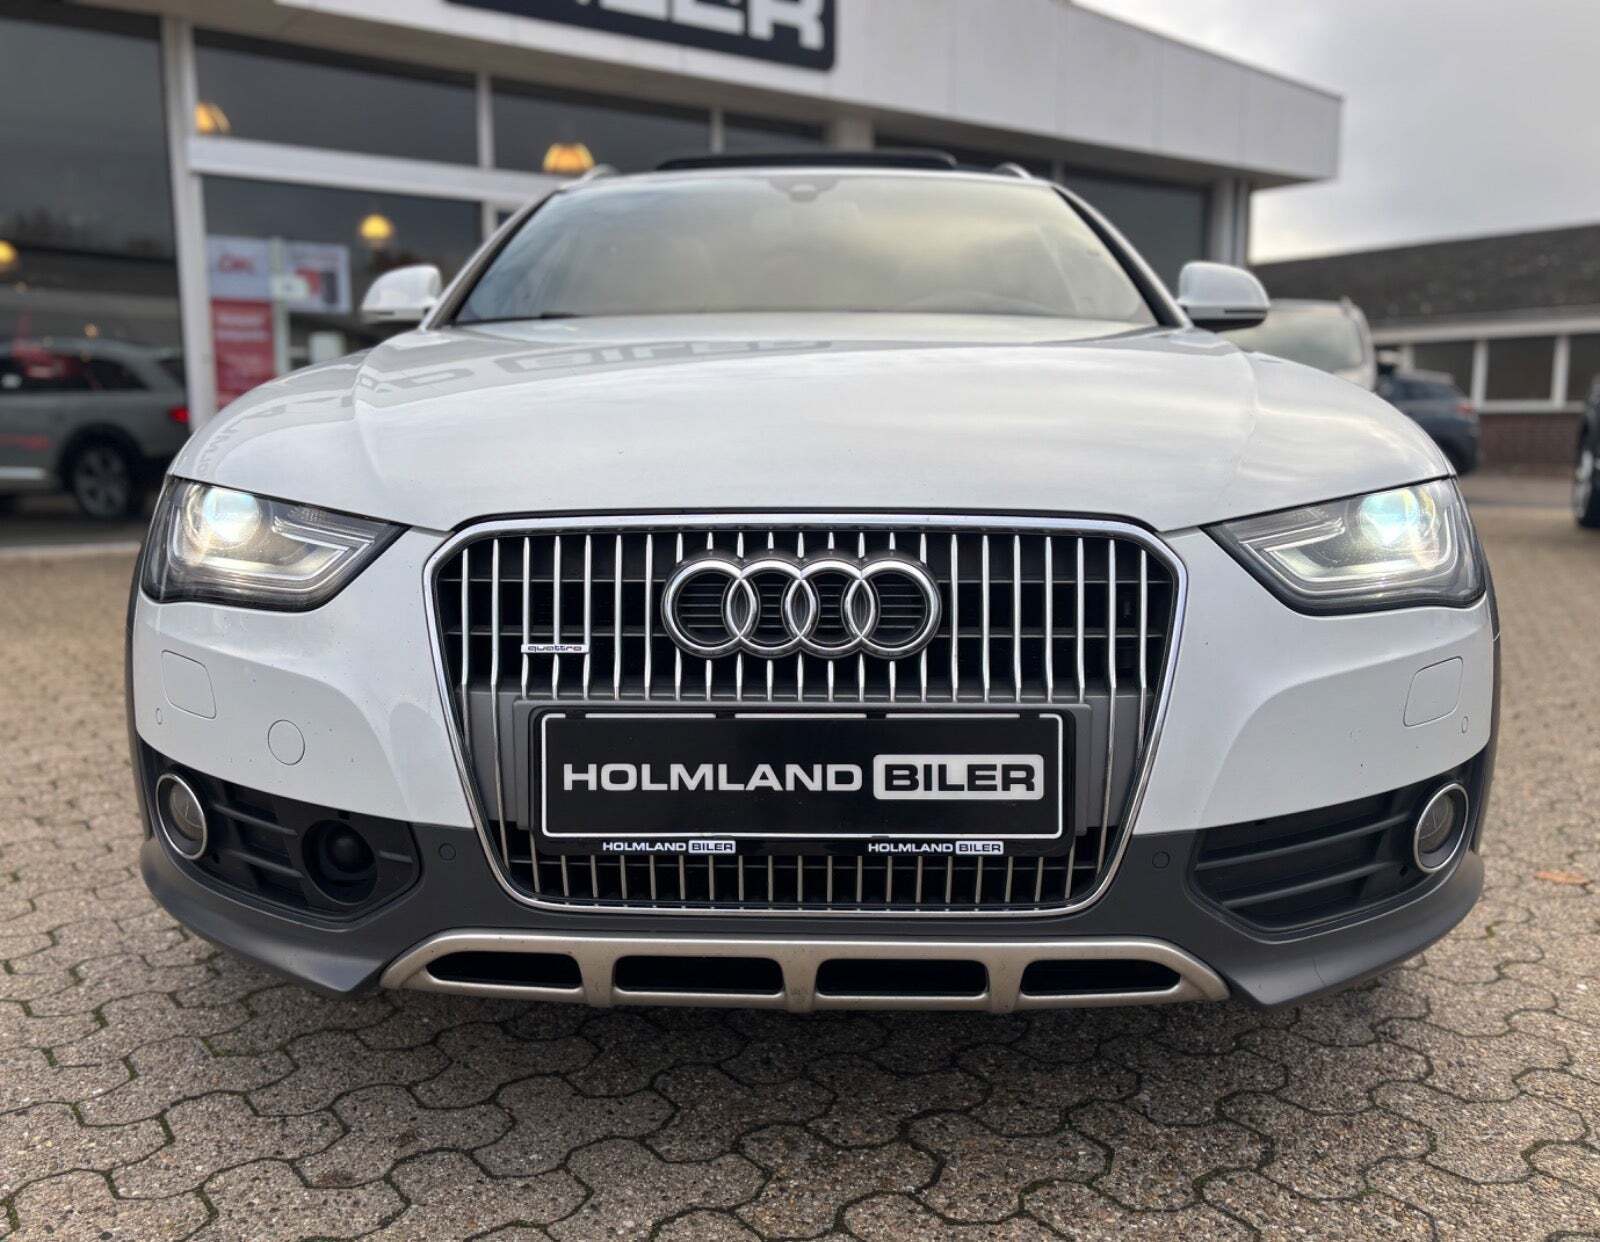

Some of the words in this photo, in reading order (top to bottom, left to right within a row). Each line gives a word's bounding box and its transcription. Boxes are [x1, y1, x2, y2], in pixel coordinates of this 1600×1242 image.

[563, 764, 863, 791] HOLMLAND
[884, 764, 1035, 791] BILER
[602, 841, 687, 851] HOLMLAND
[692, 842, 733, 851] BILER
[868, 842, 953, 852] HOLMLAND
[959, 842, 1001, 852] BILER
